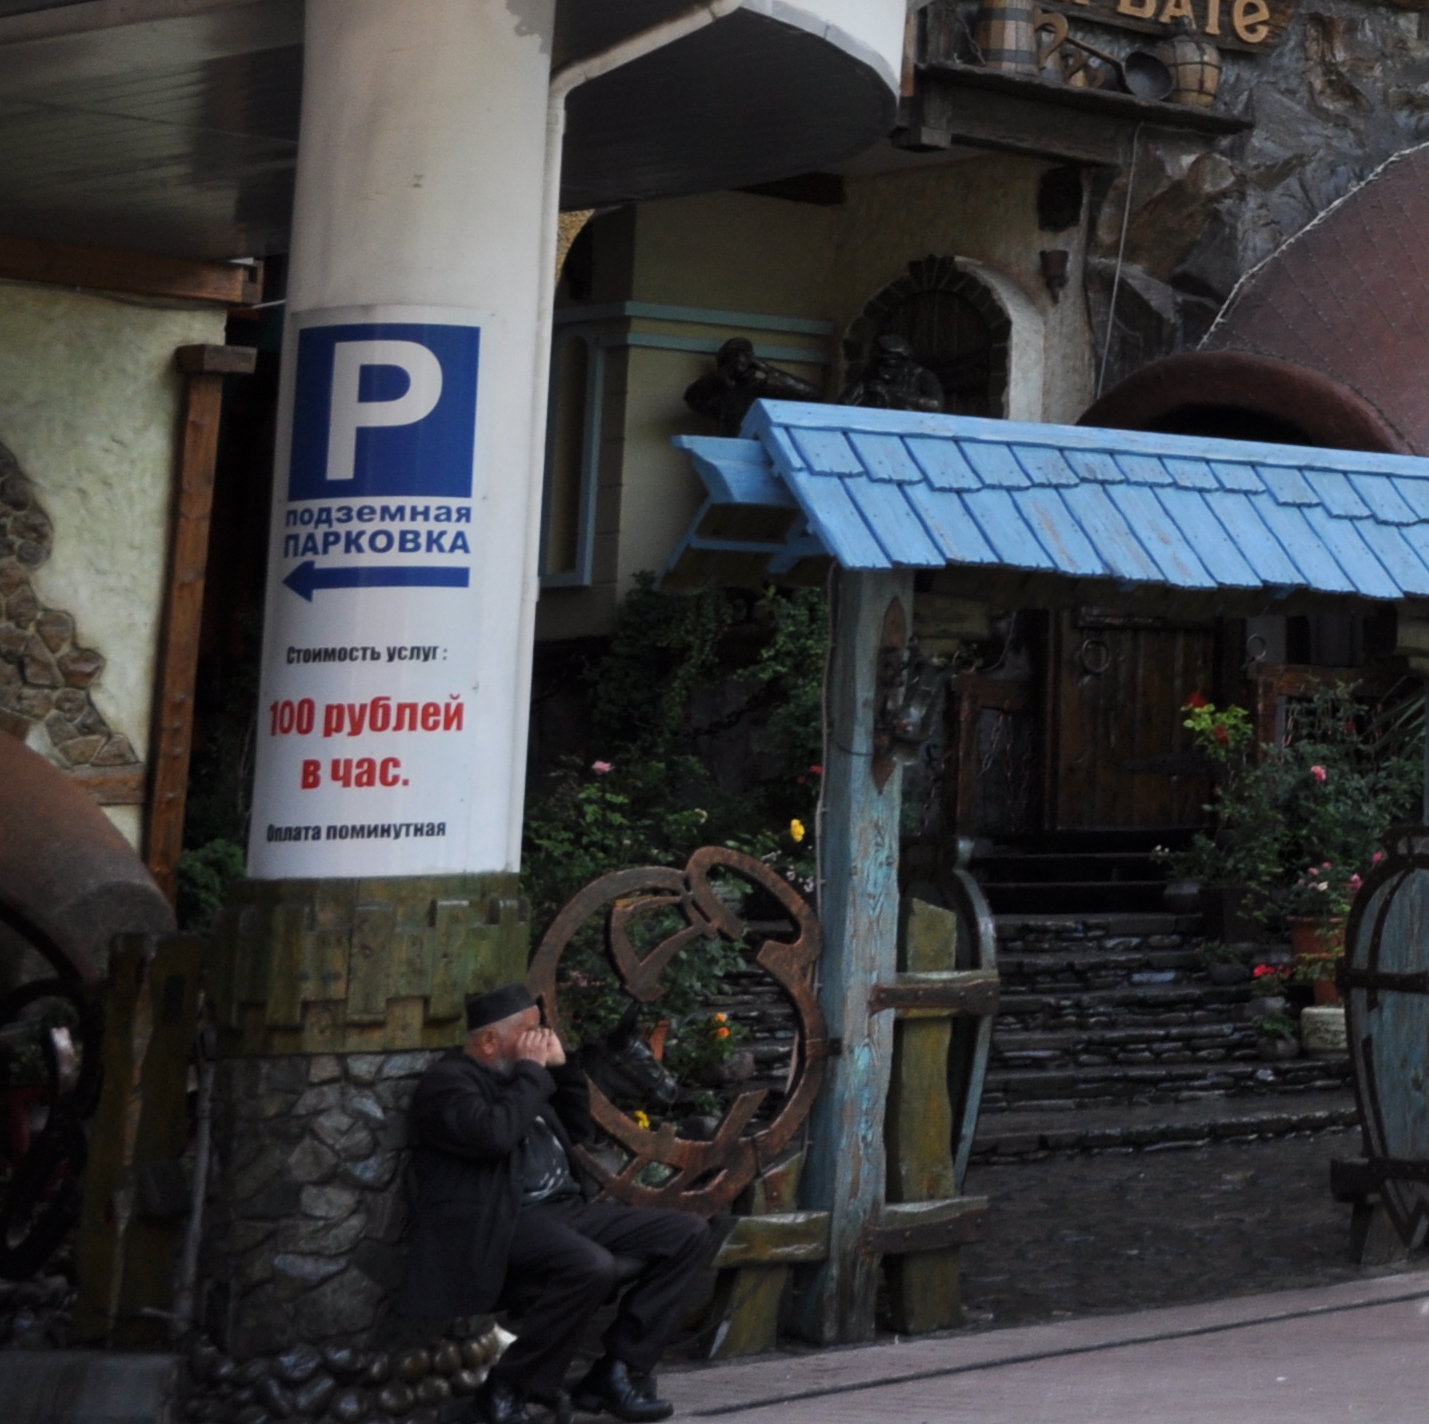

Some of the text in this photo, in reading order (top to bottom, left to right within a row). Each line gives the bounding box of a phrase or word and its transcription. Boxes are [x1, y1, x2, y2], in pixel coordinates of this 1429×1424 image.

[326, 339, 443, 481] P
[285, 504, 472, 528] подземная
[283, 529, 471, 558] ПАРКОВКА
[286, 645, 381, 664] Стоимость
[269, 694, 465, 737] 100 рублей
[301, 757, 409, 789] в час.
[266, 822, 446, 842] Оплата поминутная
